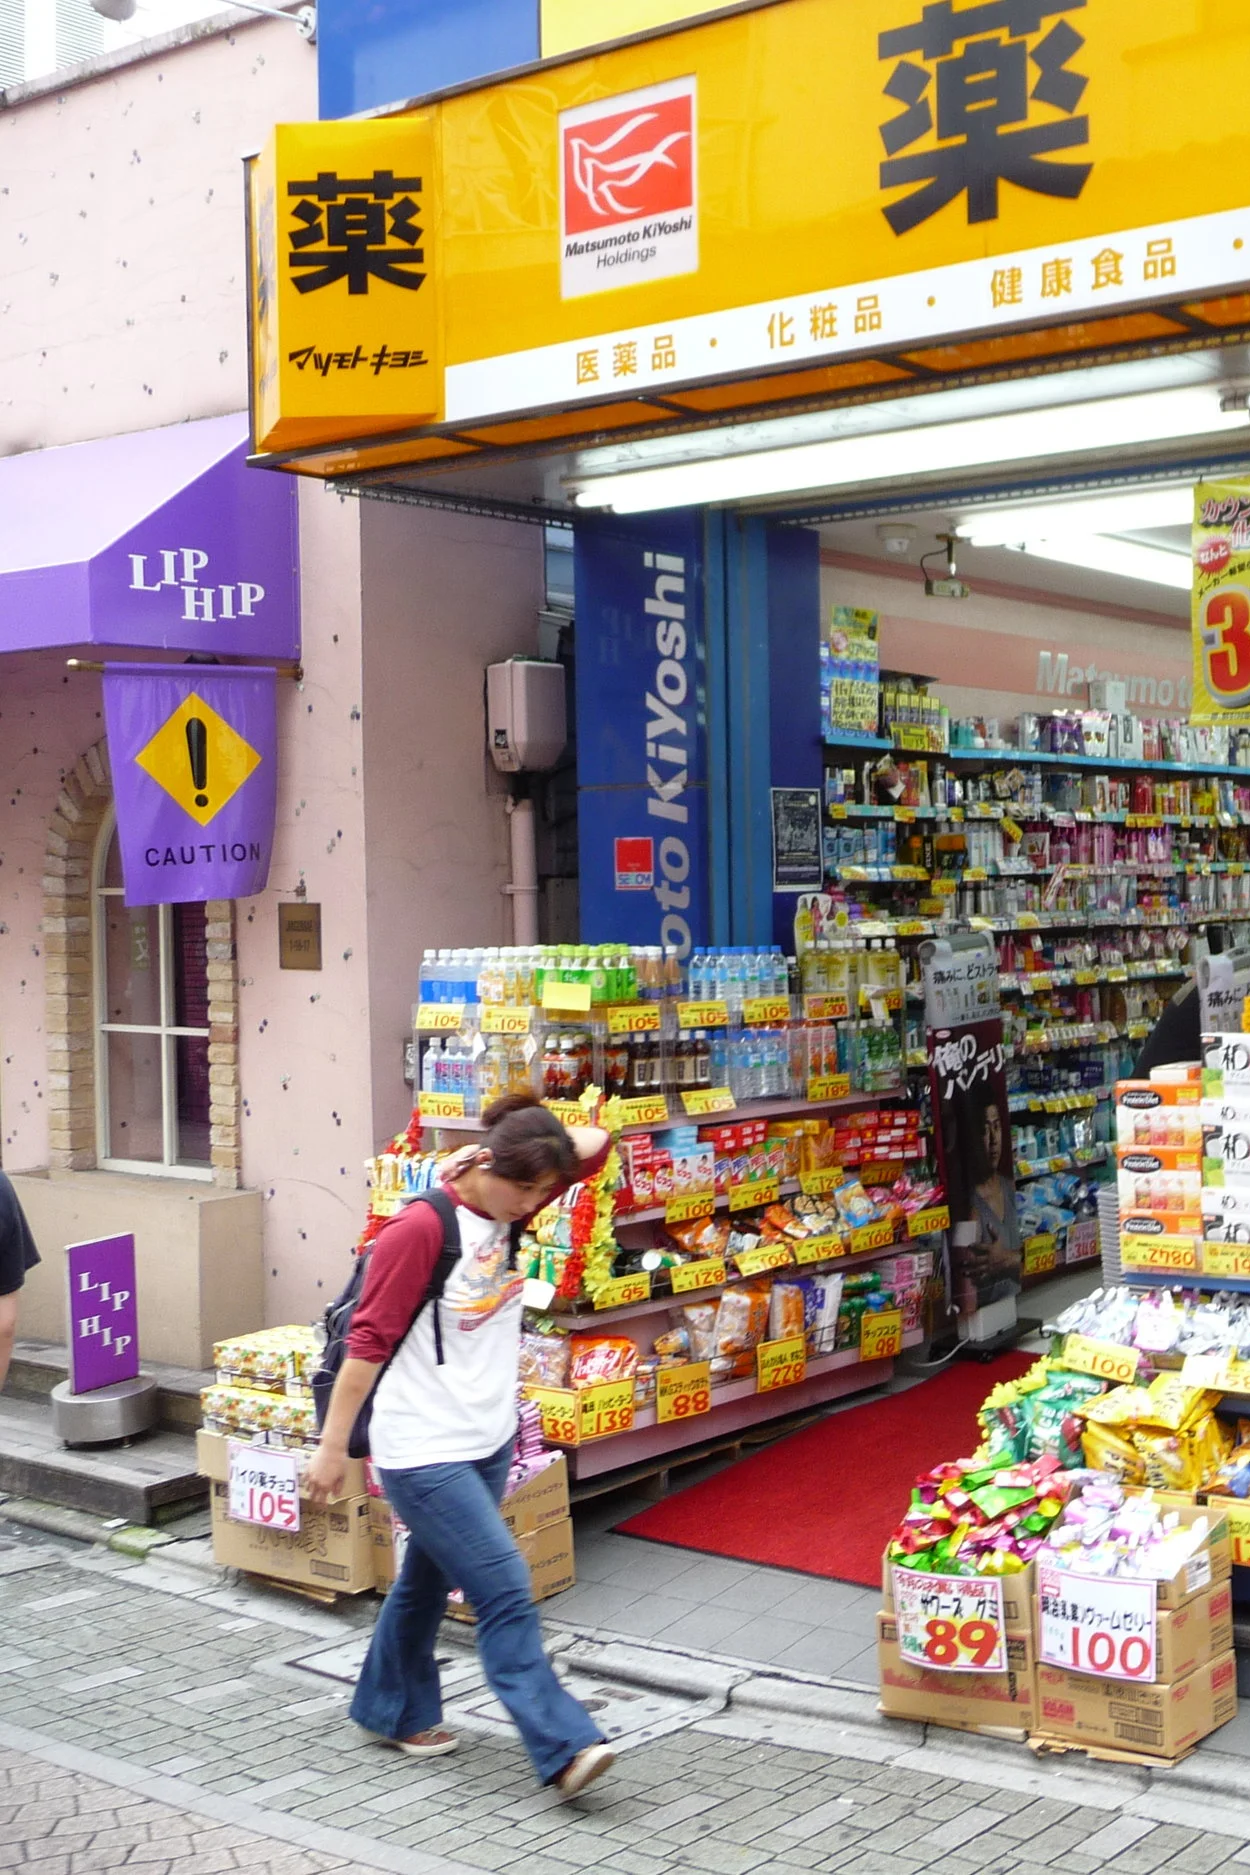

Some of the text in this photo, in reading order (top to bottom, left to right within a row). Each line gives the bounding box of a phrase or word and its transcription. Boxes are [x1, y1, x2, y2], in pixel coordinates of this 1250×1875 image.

[878, 0, 1094, 237] 薬
[287, 170, 427, 296] 薬
[565, 215, 693, 258] Matsumoto KiYoshi
[596, 245, 657, 269] Holdings
[576, 334, 677, 385] 医薬品
[765, 295, 883, 350] 化粧品
[990, 238, 1178, 310] 健康食品
[288, 344, 429, 378] マツモトキヨシ
[128, 547, 209, 592] LIP
[180, 581, 266, 622] HIP
[643, 550, 689, 824] KiYoshi
[144, 842, 262, 868] CAUTION
[617, 873, 651, 886] SEOM
[433, 1014, 460, 1026] 105
[500, 1017, 528, 1031] 105
[627, 1017, 659, 1031] 105
[699, 1010, 729, 1024] 105
[762, 1005, 791, 1019] 105
[435, 1103, 464, 1117] 105
[637, 1106, 667, 1121] 105
[753, 1190, 774, 1204] 99
[684, 1203, 714, 1219] 100
[924, 1216, 949, 1231] 100
[868, 1231, 893, 1246] 100
[760, 1252, 791, 1270] 100
[815, 1244, 844, 1258] 158
[693, 1268, 725, 1285] 128
[77, 1271, 130, 1312] LIP
[621, 1285, 645, 1301] 95
[78, 1314, 132, 1357] HIP
[875, 1337, 896, 1355] 98
[771, 1363, 805, 1387] 228
[1090, 1354, 1132, 1378] 100
[672, 1390, 710, 1417] 88
[540, 1418, 577, 1441] 38
[596, 1407, 634, 1434] 138
[248, 1487, 297, 1527] 105
[925, 1618, 998, 1667] 89
[1071, 1626, 1151, 1677] 100
